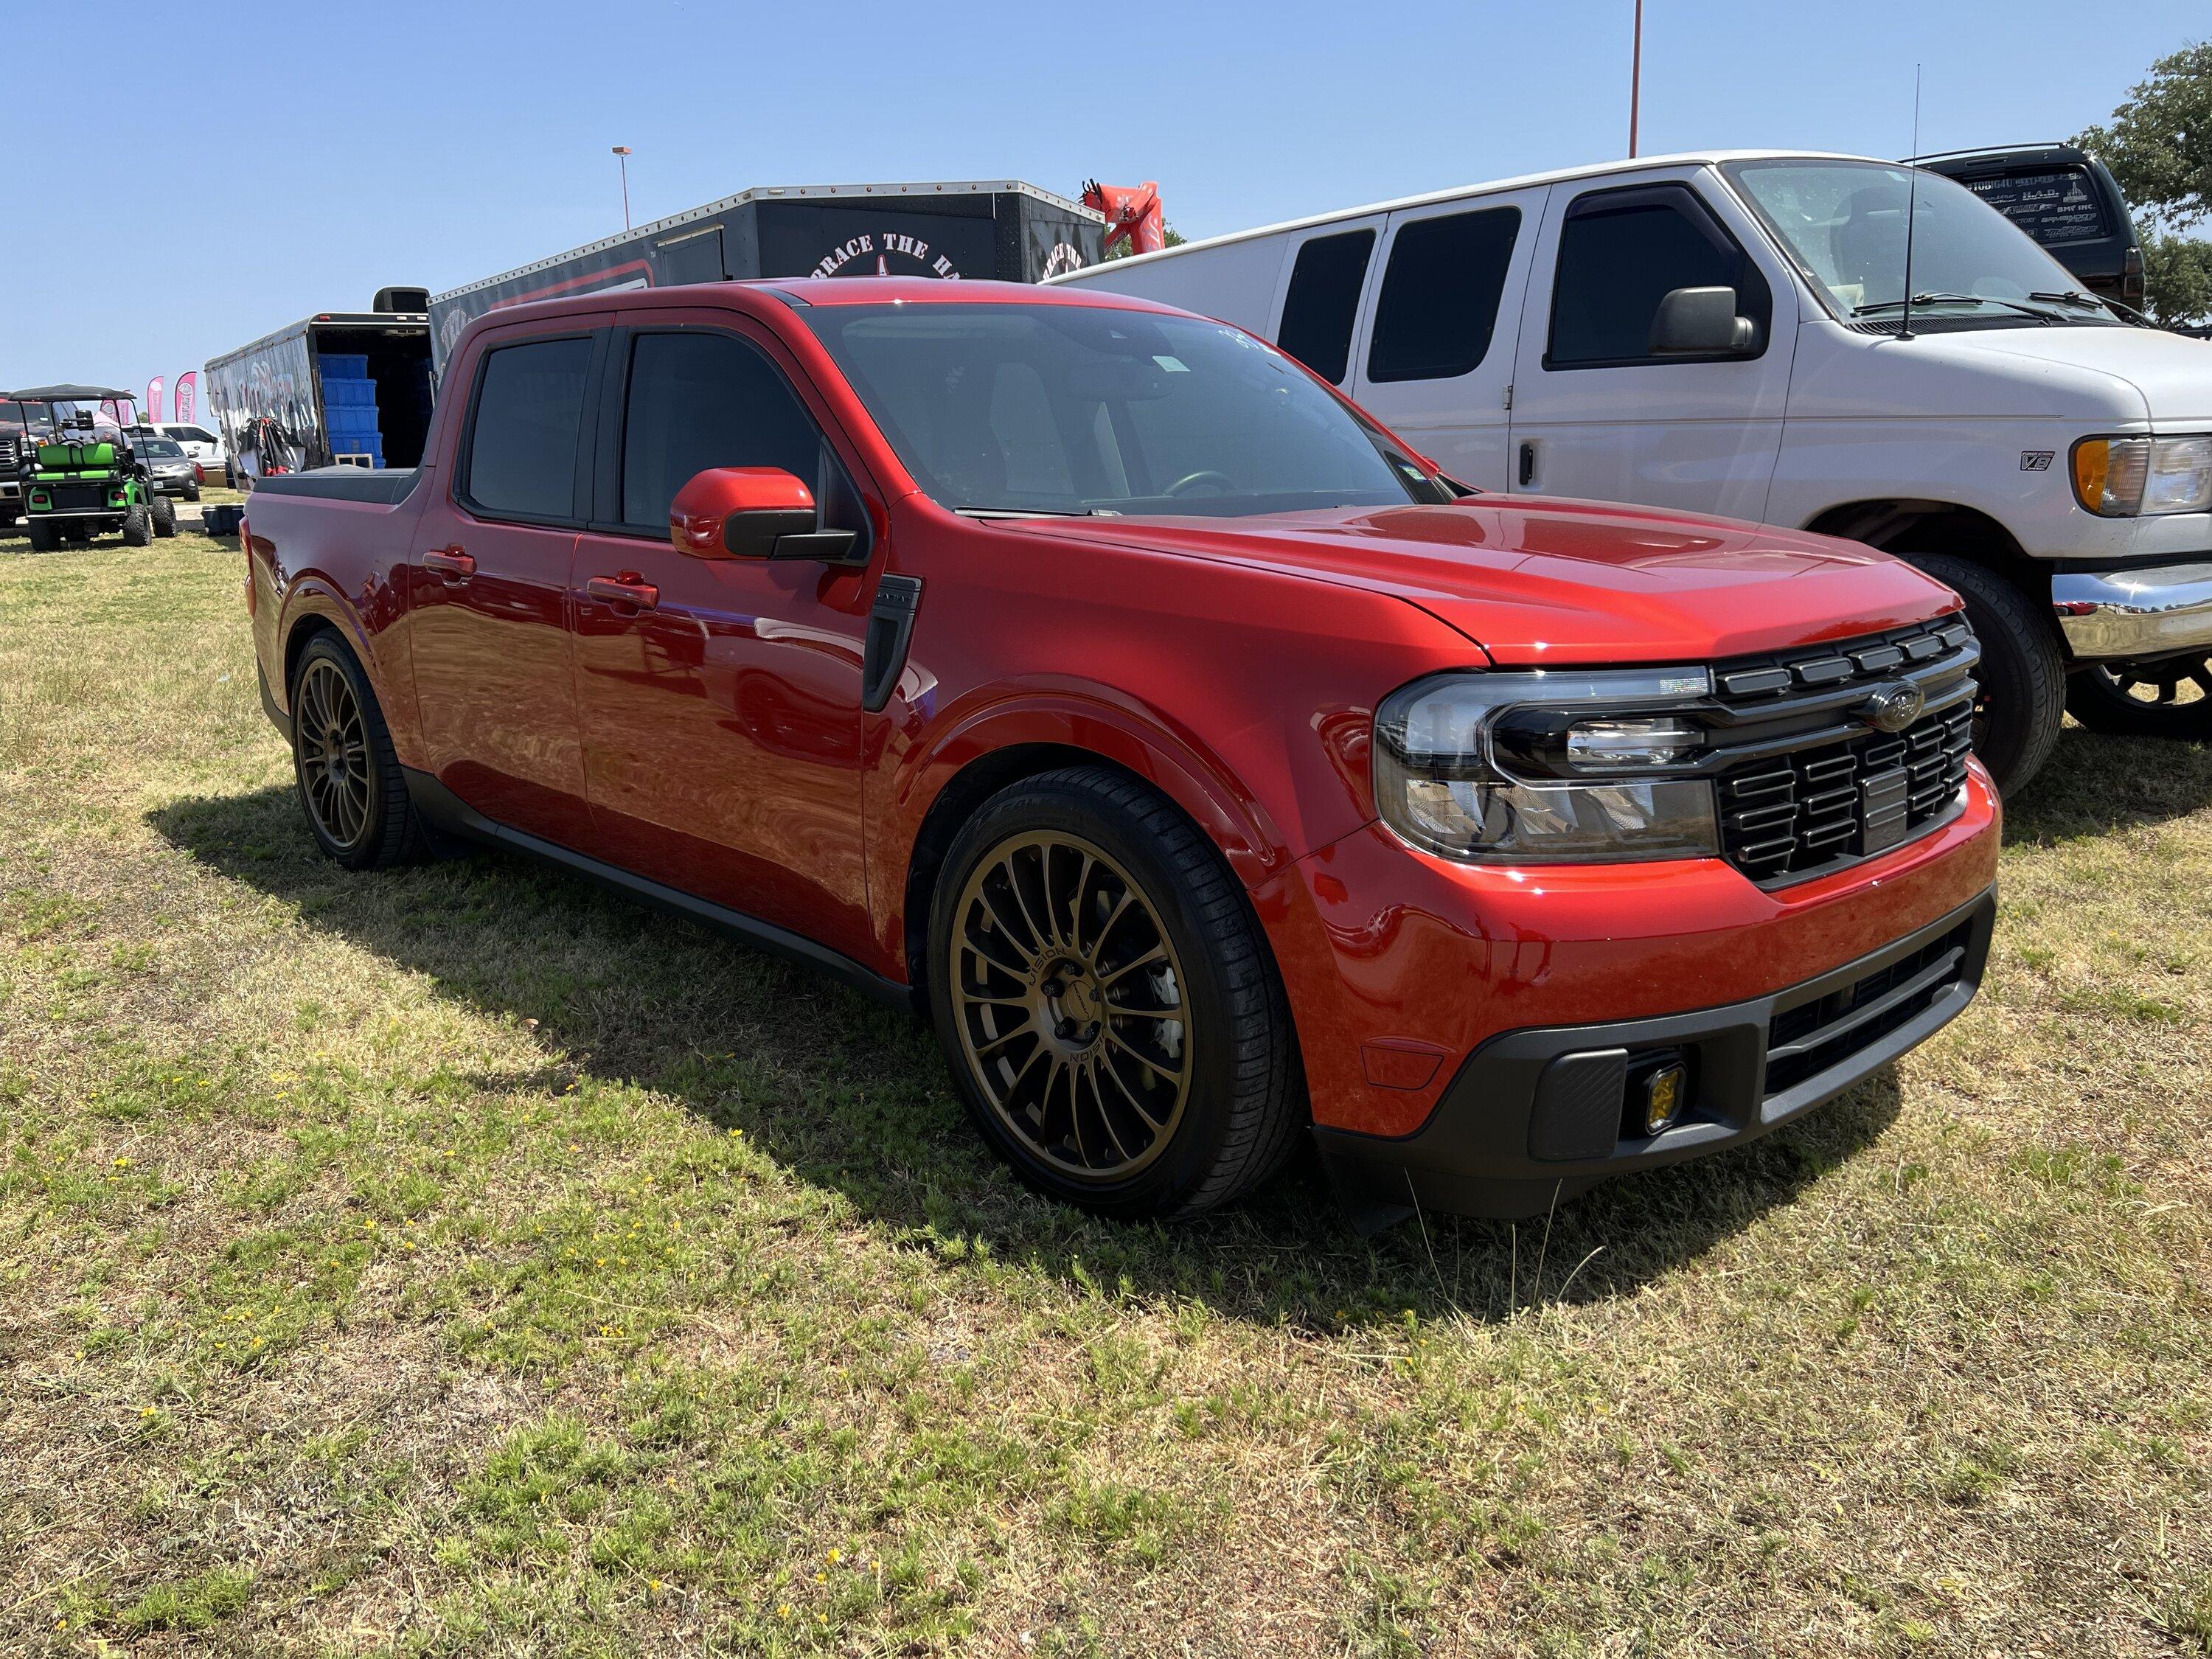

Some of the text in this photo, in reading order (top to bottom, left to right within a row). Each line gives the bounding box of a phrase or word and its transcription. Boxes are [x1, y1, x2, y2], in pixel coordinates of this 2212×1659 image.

[883, 232, 929, 260] THE
[1065, 243, 1082, 271] THE
[2022, 455, 2051, 470] V8
[1029, 947, 1067, 987] VISION
